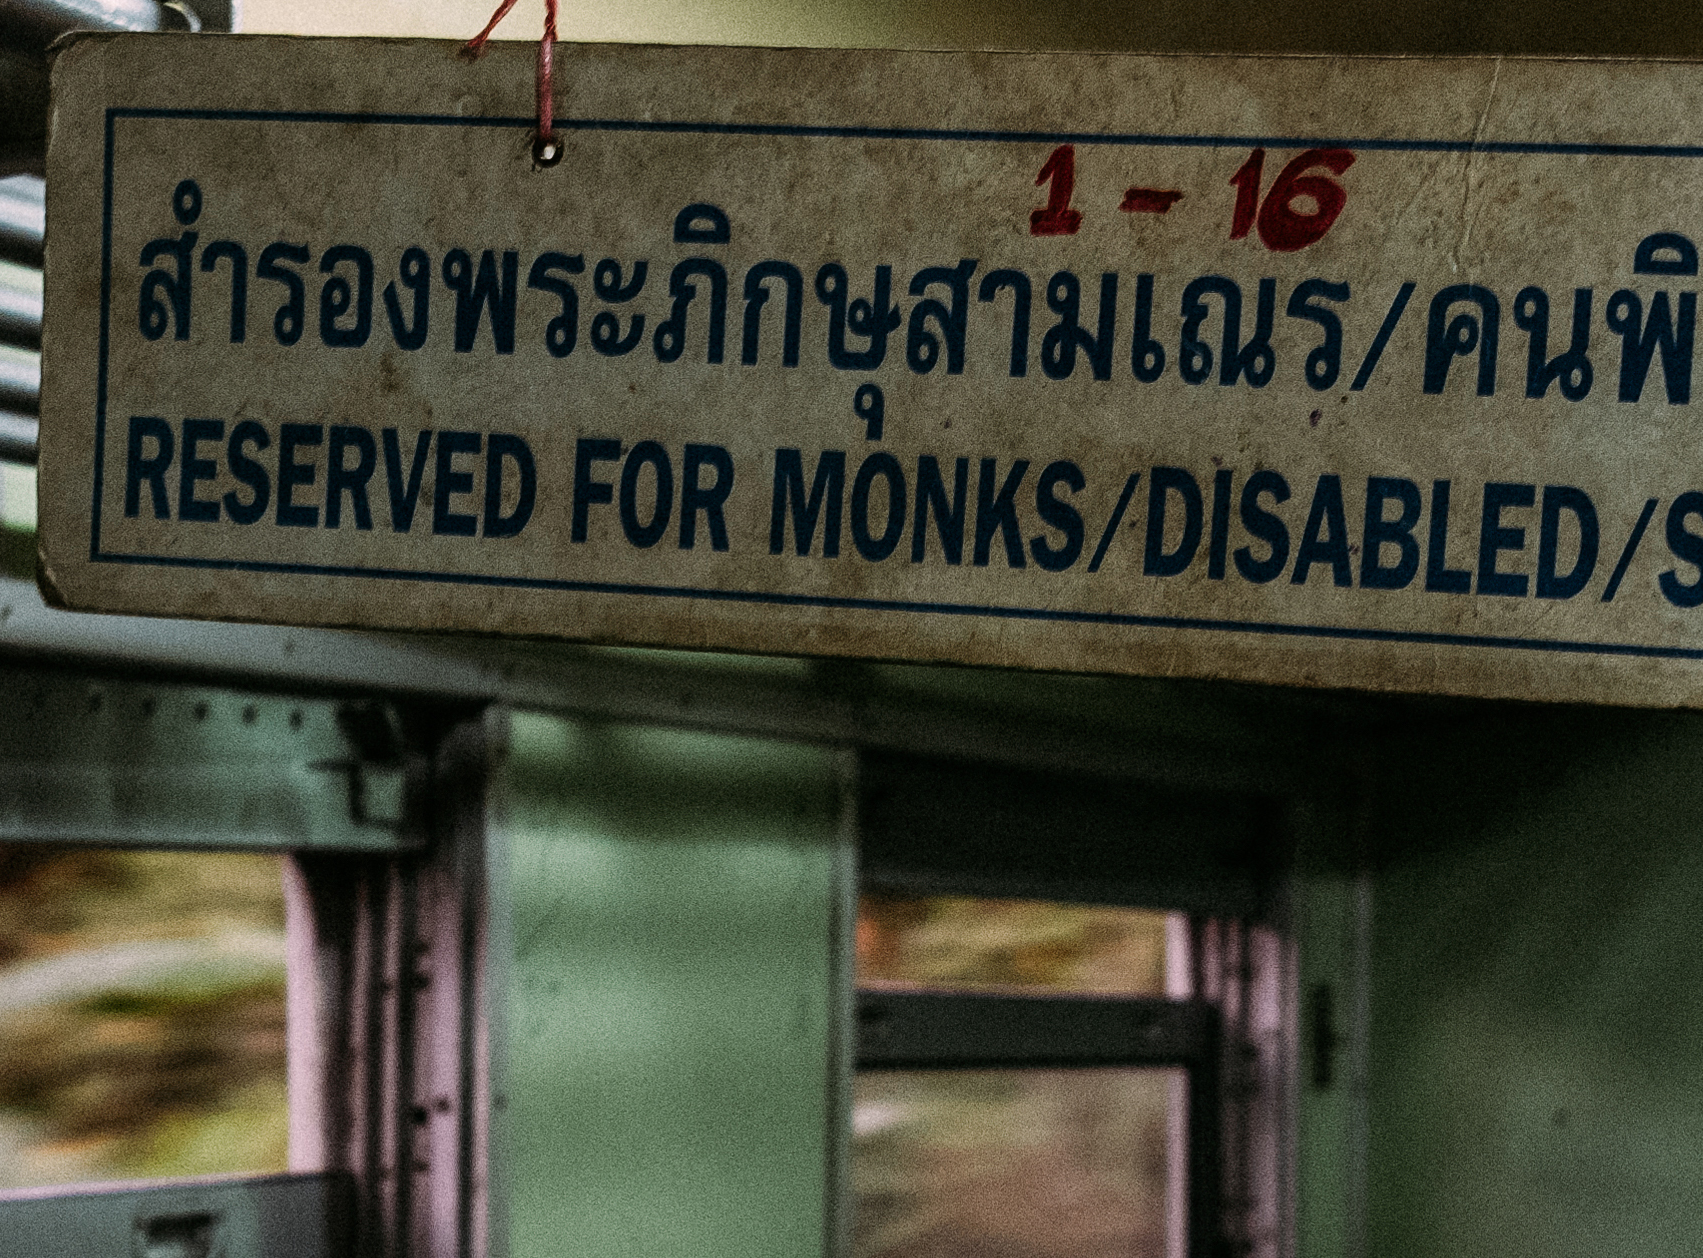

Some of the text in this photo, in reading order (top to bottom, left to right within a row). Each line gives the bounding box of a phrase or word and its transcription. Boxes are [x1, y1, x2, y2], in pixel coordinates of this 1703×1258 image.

[1030, 144, 1081, 238] 1
[1229, 149, 1356, 252] 16
[125, 415, 536, 540] RESERVED
[572, 437, 733, 550] FOR
